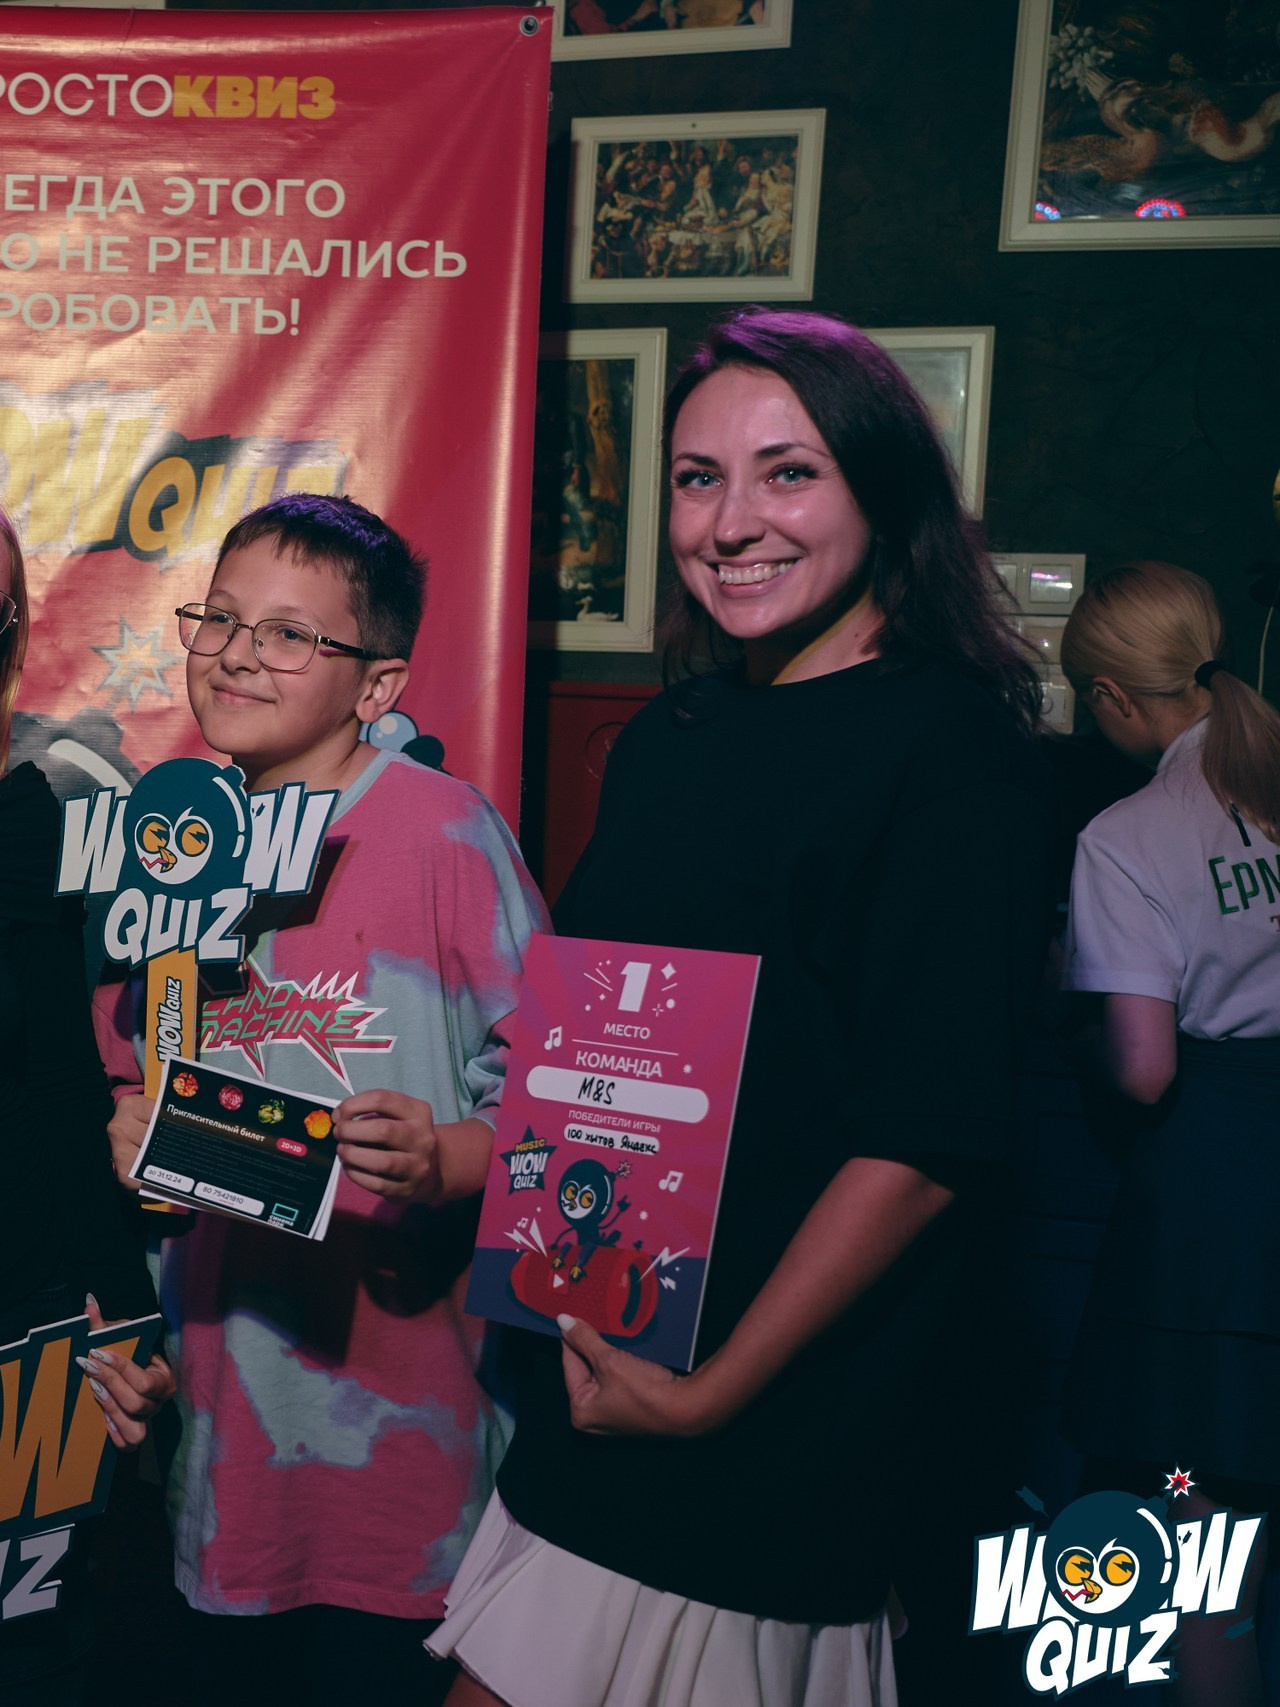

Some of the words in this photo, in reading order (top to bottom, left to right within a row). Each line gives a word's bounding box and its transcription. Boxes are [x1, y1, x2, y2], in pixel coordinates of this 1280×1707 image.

[162, 176, 346, 218] ЭТОГО
[58, 235, 129, 273] НЕ
[147, 236, 468, 278] РЕШАЛИСЬ
[104, 887, 249, 965] QUIZ
[618, 961, 651, 1012] 1
[603, 1022, 651, 1040] МЕСТО
[575, 1050, 663, 1078] КОМАНДА
[577, 1076, 615, 1105] M&S
[166, 1103, 239, 1134] Пригласительный
[240, 1127, 265, 1142] билет
[567, 1128, 583, 1140] 100
[568, 1109, 631, 1128] ПОБЕДИТЕЛИ
[632, 1121, 661, 1133] ИГРЫ
[515, 1138, 546, 1152] MUSIC
[509, 1152, 549, 1175] WOW
[513, 1175, 538, 1189] QUIZ
